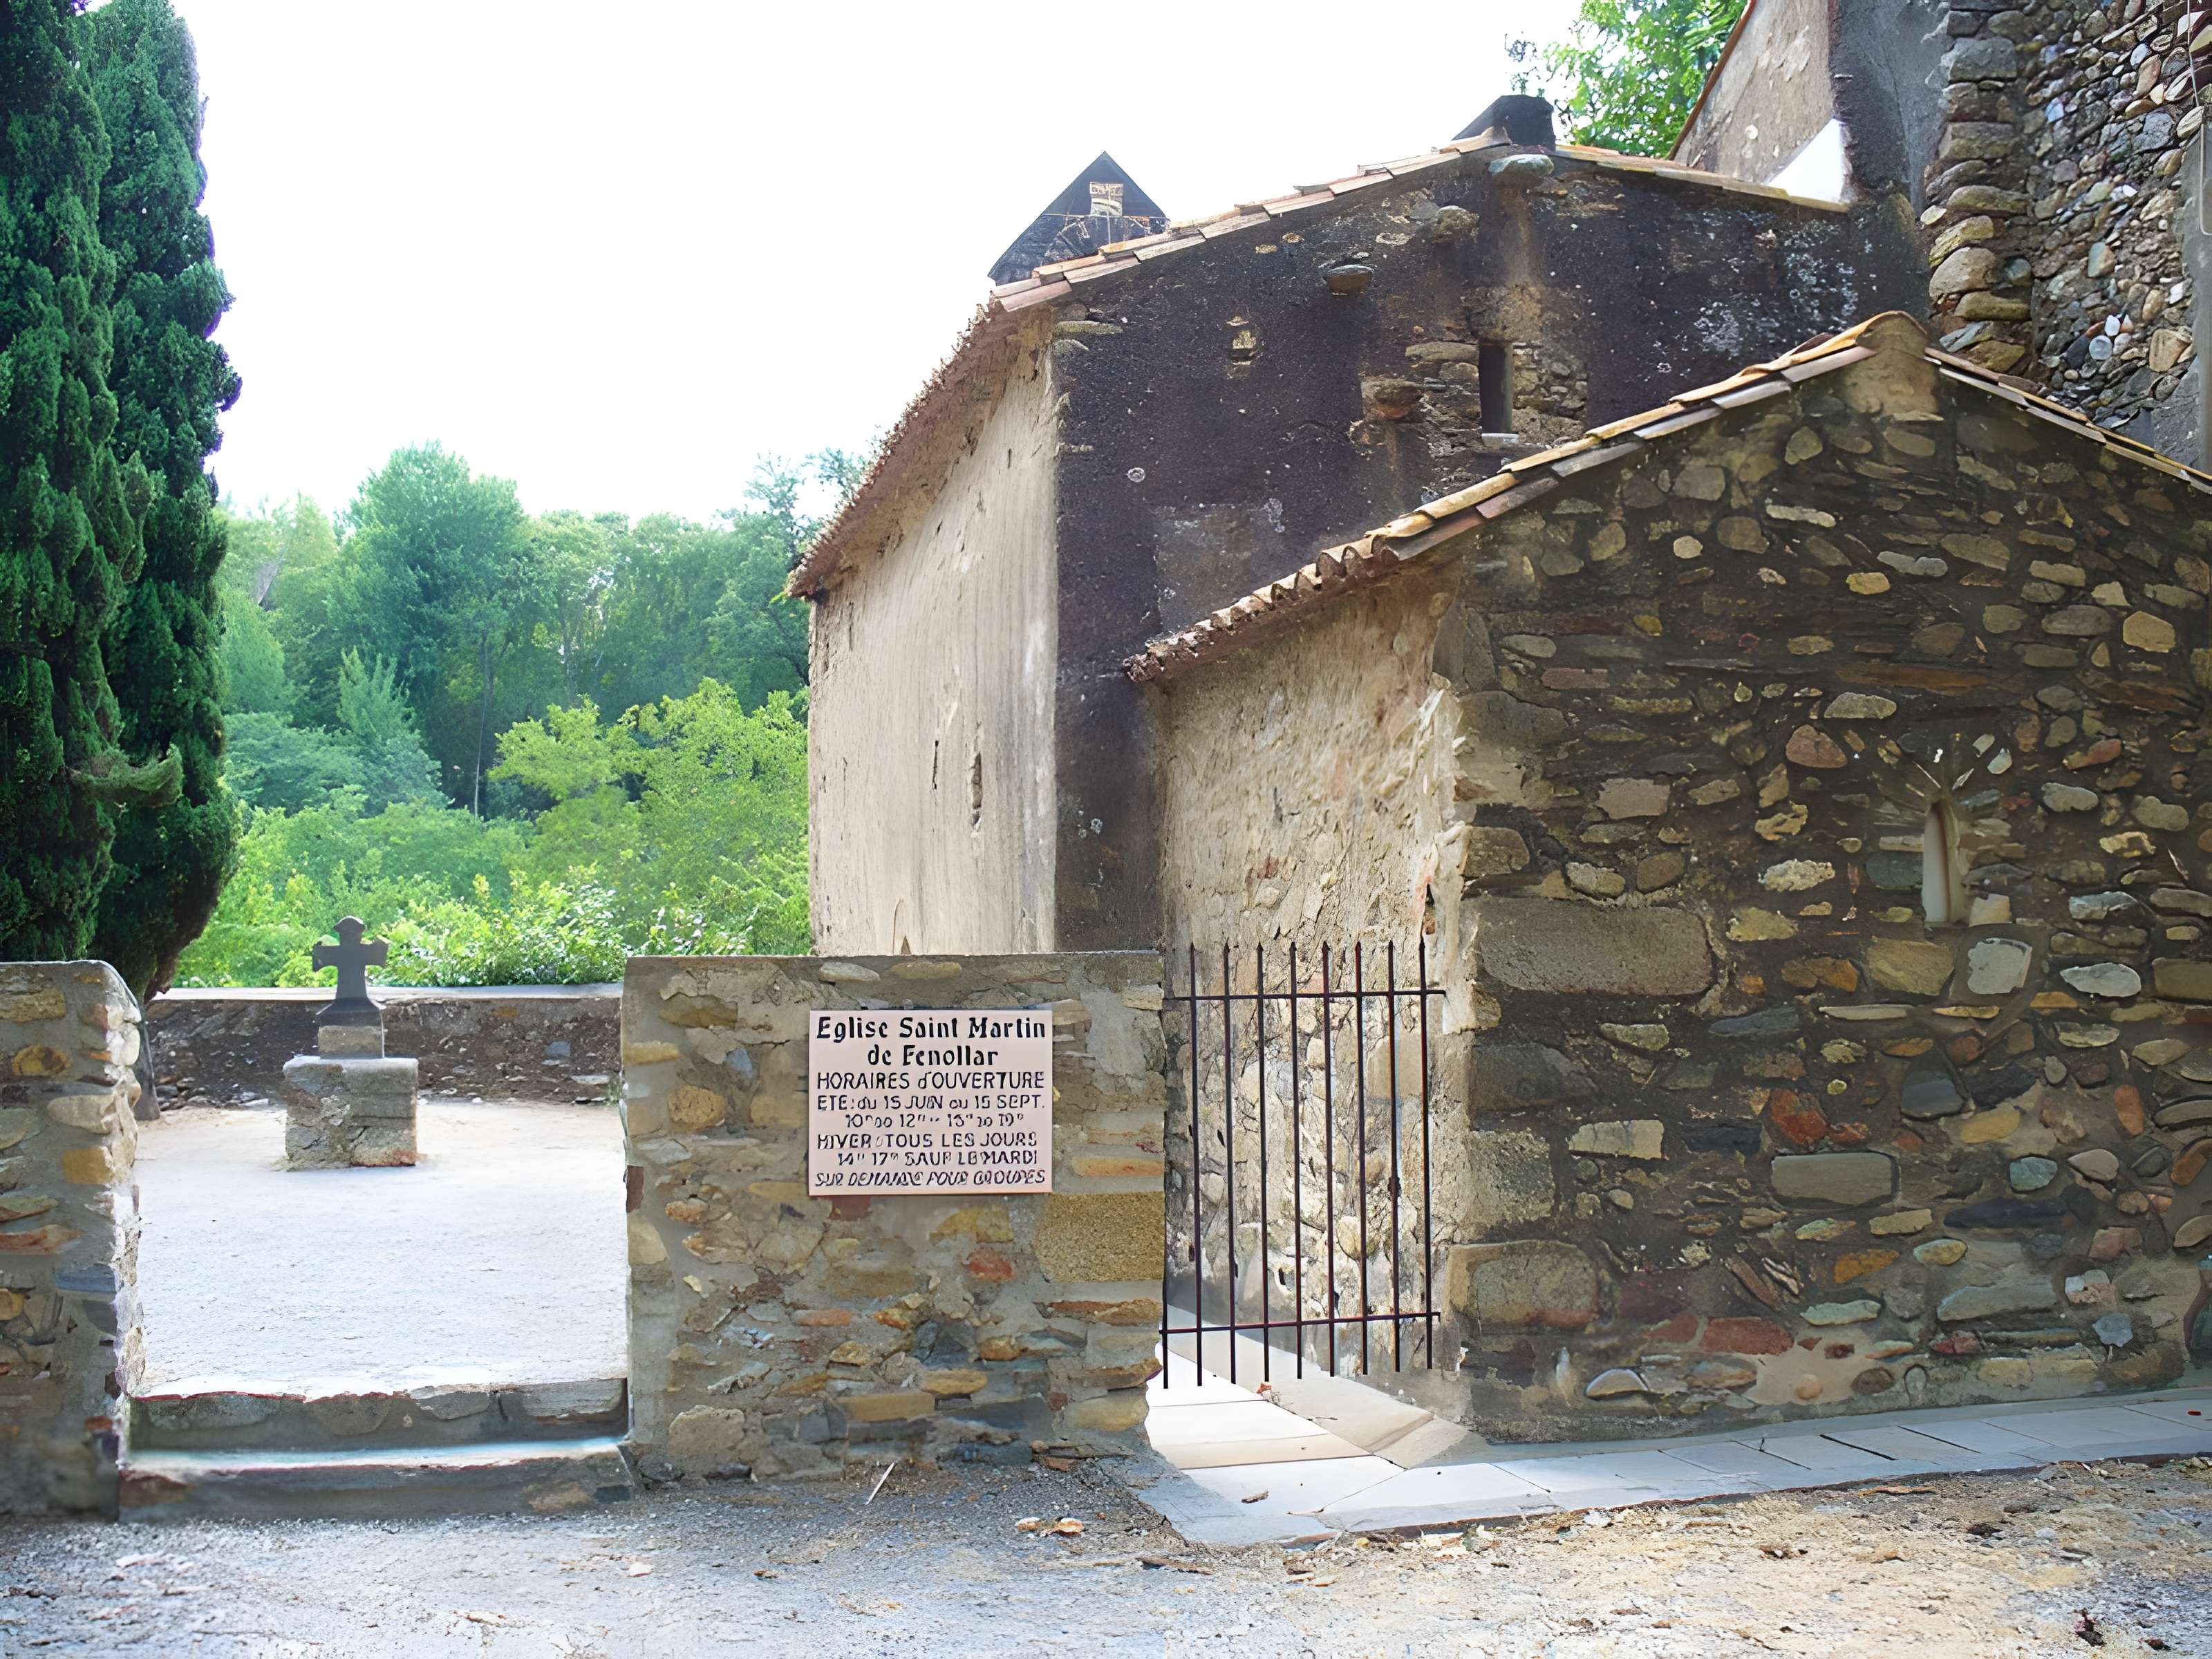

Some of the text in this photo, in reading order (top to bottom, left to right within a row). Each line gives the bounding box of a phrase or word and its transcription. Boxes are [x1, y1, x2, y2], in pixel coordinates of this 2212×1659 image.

[816, 1016, 1046, 1043] Eglise Saint Martin
[868, 1044, 999, 1066] de Fenollar
[817, 1072, 910, 1089] HORAIRES
[883, 1096, 901, 1109] 15
[885, 1134, 932, 1148] TOUS
[941, 1132, 975, 1147] LES
[980, 1132, 1038, 1147] JOURS
